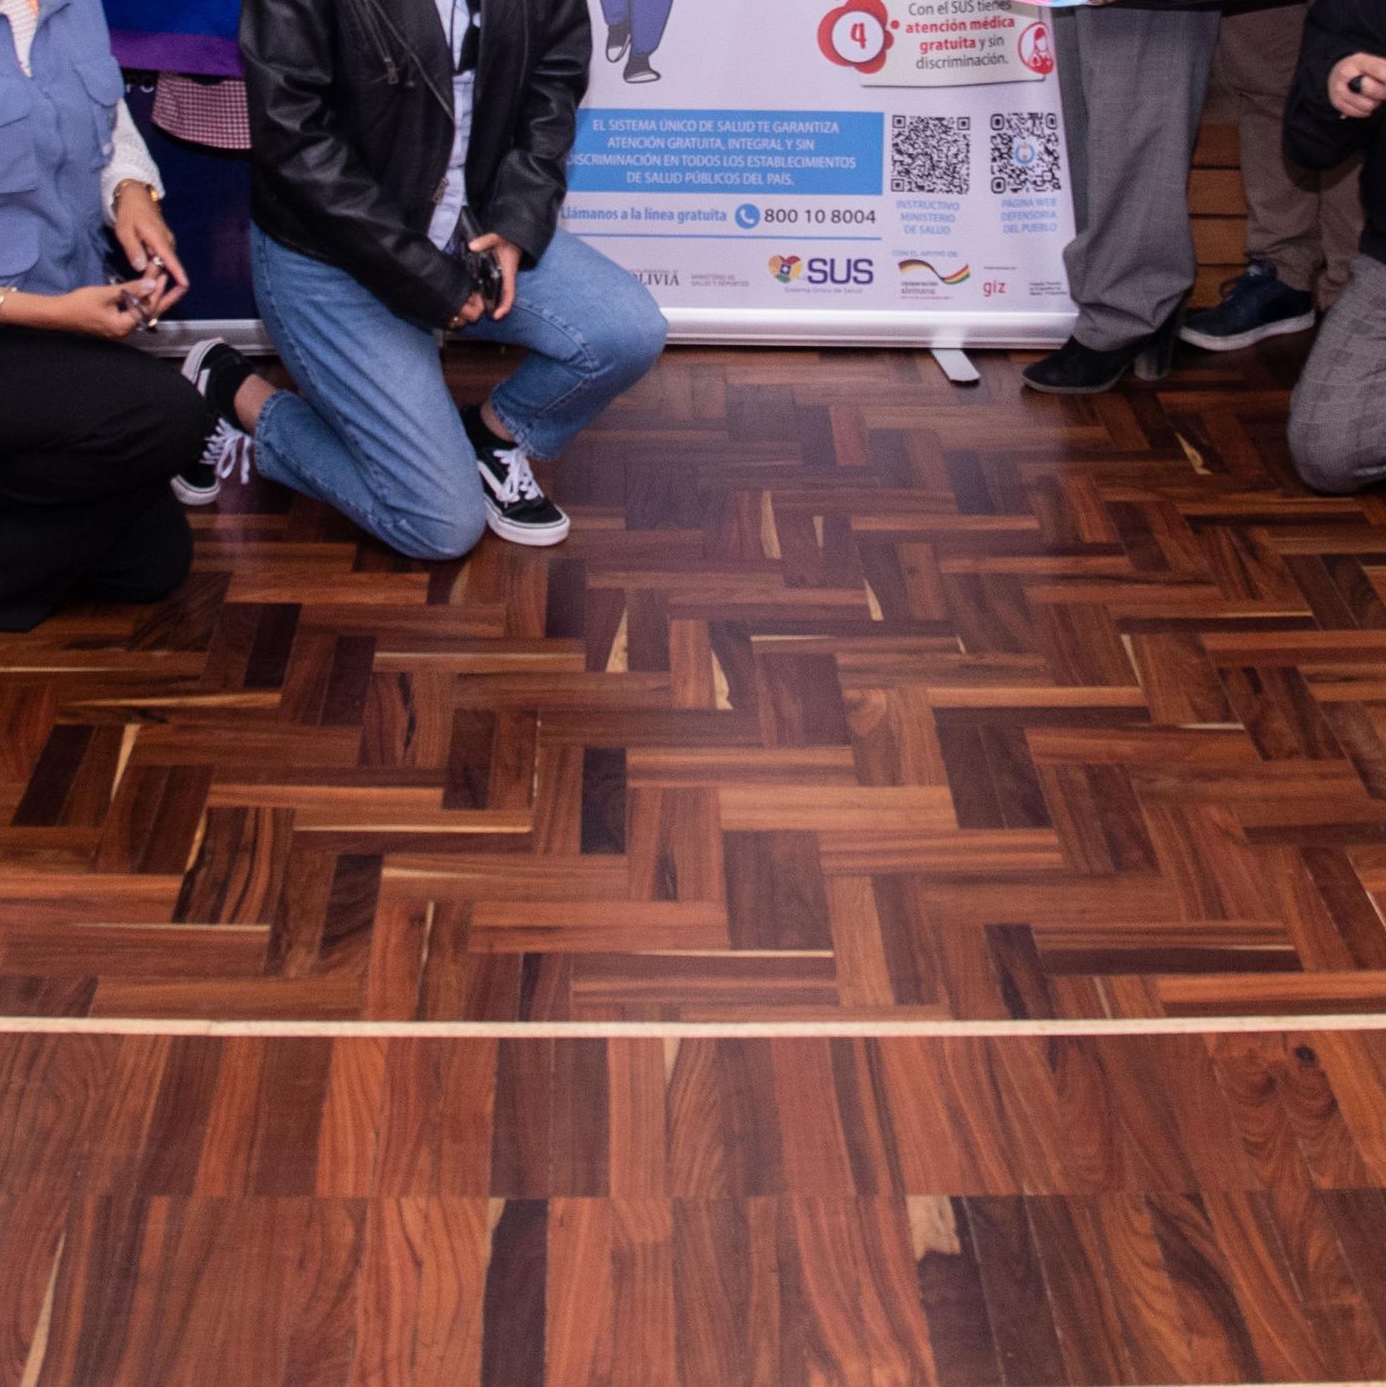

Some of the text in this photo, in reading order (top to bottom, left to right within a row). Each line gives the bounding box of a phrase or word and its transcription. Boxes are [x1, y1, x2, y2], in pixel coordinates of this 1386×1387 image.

[908, 0, 1012, 16] Con el SUS tienes
[905, 17, 1015, 34] atención médica
[850, 22, 866, 50] 4
[919, 35, 1004, 54] gratuita y sin
[915, 54, 1008, 70] discriminación.
[593, 118, 840, 133] EL SISTEMA ÚNICO DE SALUD TE GARANTIZA
[607, 136, 815, 151] ATENCIÓN GRATUITA, INTEGRAL Y SIN
[664, 154, 679, 166] EN
[682, 155, 721, 167] TODOS
[723, 155, 746, 167] LOS
[748, 156, 856, 169] ESTABLECIMIENTOS
[627, 171, 795, 186] DE SALUD PÚBLICOS DEL PAÍS.
[896, 199, 960, 211] INSTRUCTIVO
[1036, 197, 1057, 207] WEB
[620, 210, 628, 220] a
[631, 207, 642, 220] la
[644, 207, 674, 221] línea
[677, 208, 727, 224] gratuita
[765, 208, 876, 224] 800 10 8004
[919, 225, 951, 235] SALUD
[807, 258, 874, 285] SUS
[983, 279, 1006, 297] giz
